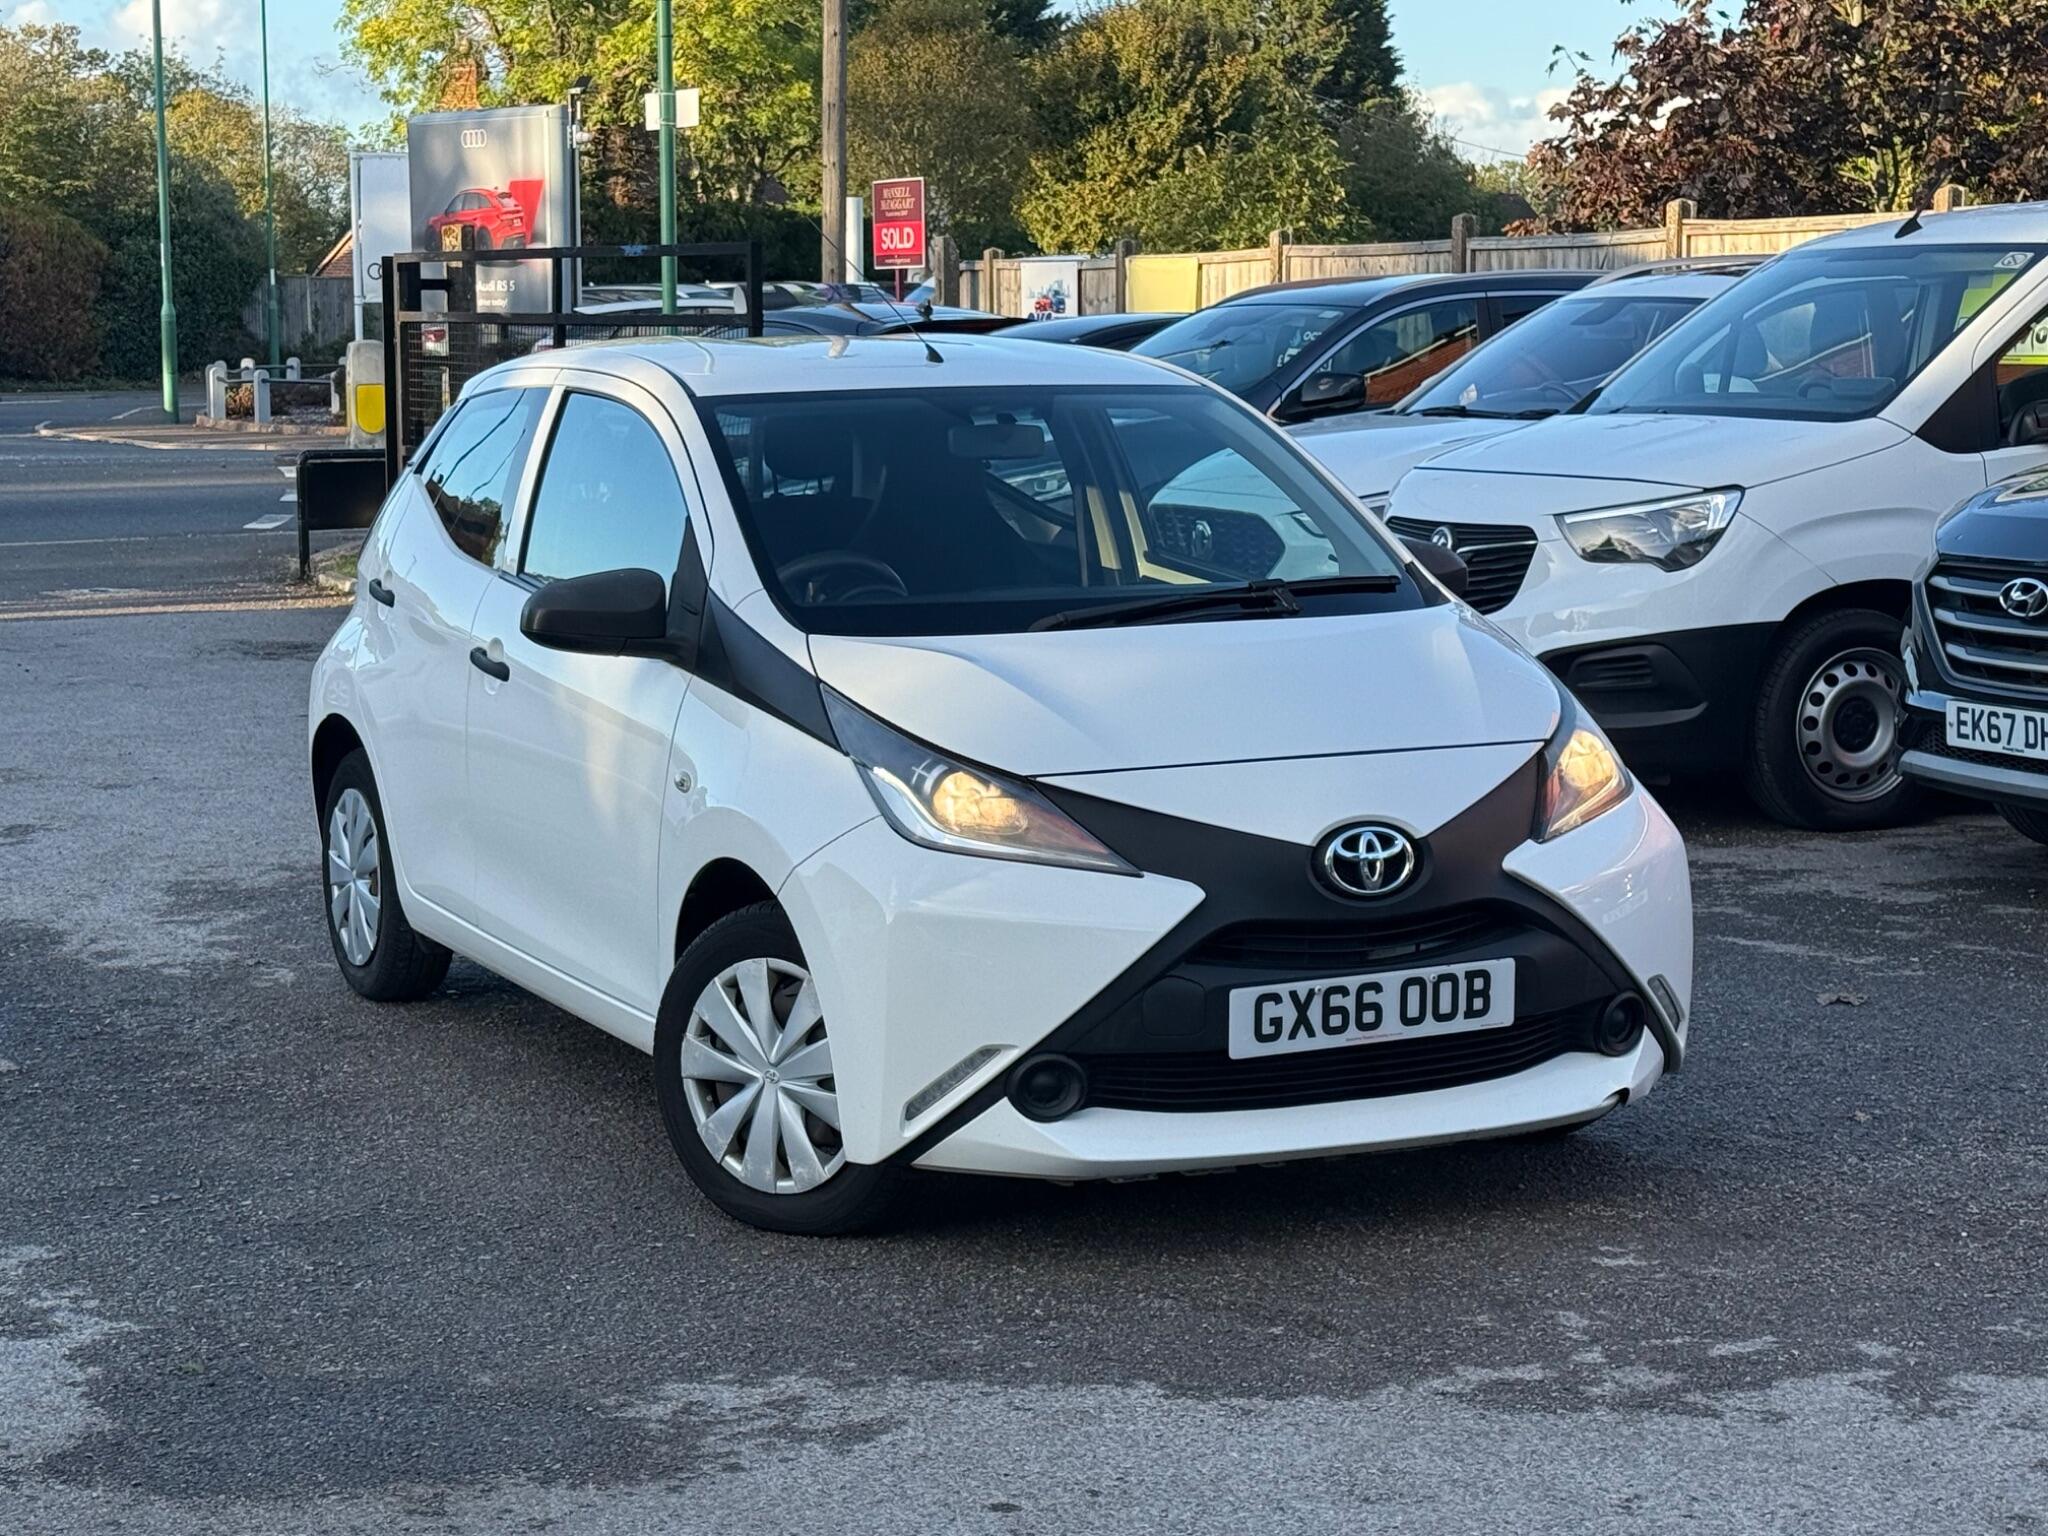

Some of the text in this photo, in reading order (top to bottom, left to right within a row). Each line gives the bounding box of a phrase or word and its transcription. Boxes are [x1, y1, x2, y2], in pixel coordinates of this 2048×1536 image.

[881, 226, 915, 250] SOLD
[509, 279, 516, 292] 5
[1956, 706, 2016, 746] EK67
[1254, 968, 1492, 1043] GX66 OOB
